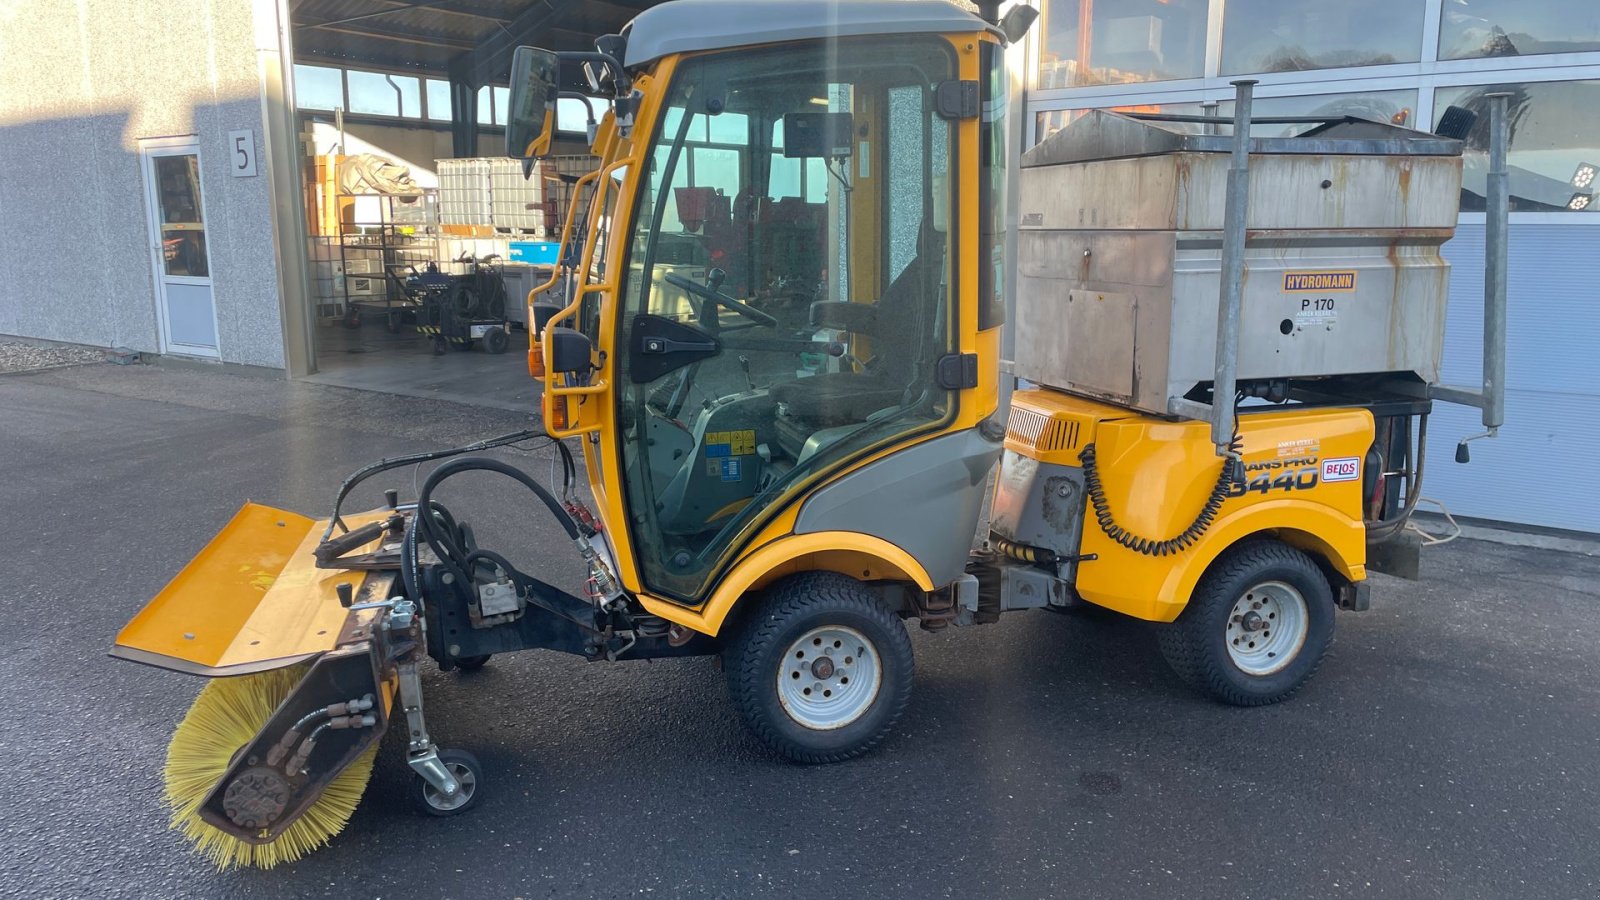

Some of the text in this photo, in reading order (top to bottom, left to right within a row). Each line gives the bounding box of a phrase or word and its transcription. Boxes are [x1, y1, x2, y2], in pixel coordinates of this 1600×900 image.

[235, 136, 249, 170] 5
[1287, 274, 1352, 289] HYDROMANN
[1301, 298, 1335, 311] P 170
[1326, 462, 1356, 475] BELOS
